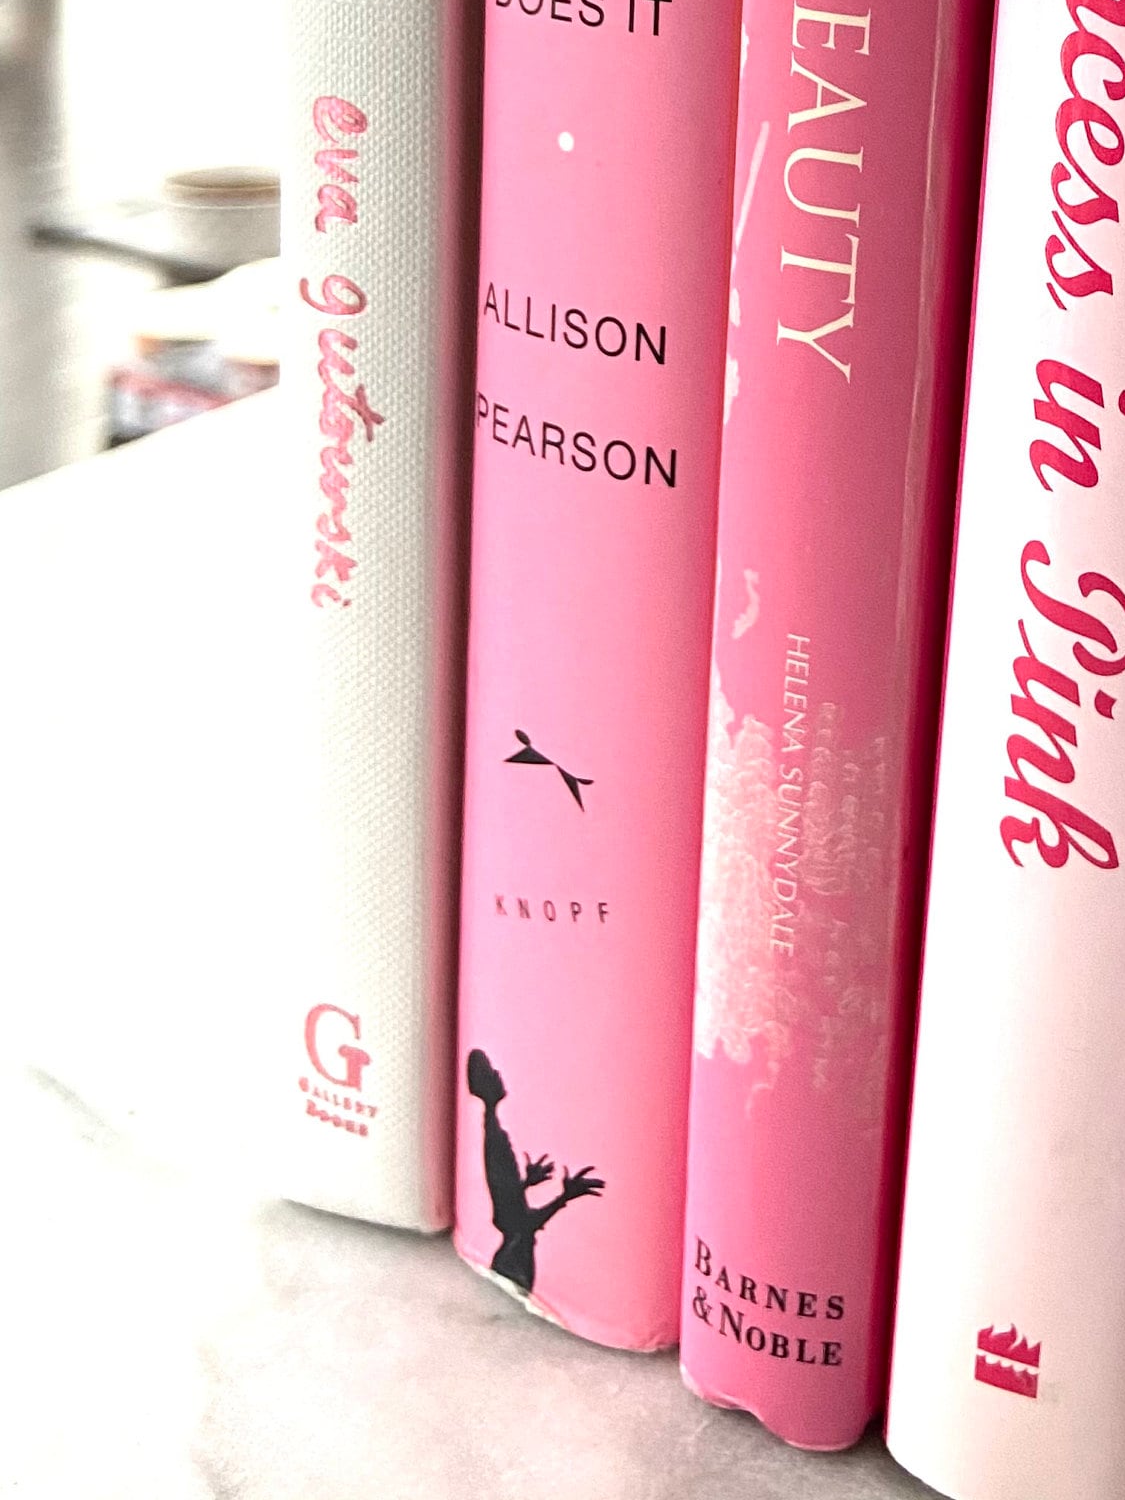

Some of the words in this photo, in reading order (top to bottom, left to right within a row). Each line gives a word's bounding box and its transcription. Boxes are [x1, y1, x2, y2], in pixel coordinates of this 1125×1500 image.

[312, 95, 368, 234] eva
[483, 281, 668, 366] ALLISON
[475, 391, 679, 489] PEARSON
[778, 632, 811, 755] HELENA
[494, 893, 610, 925] KNOPF
[768, 762, 804, 959] SUNNYDALE
[693, 1233, 846, 1322] BARNES
